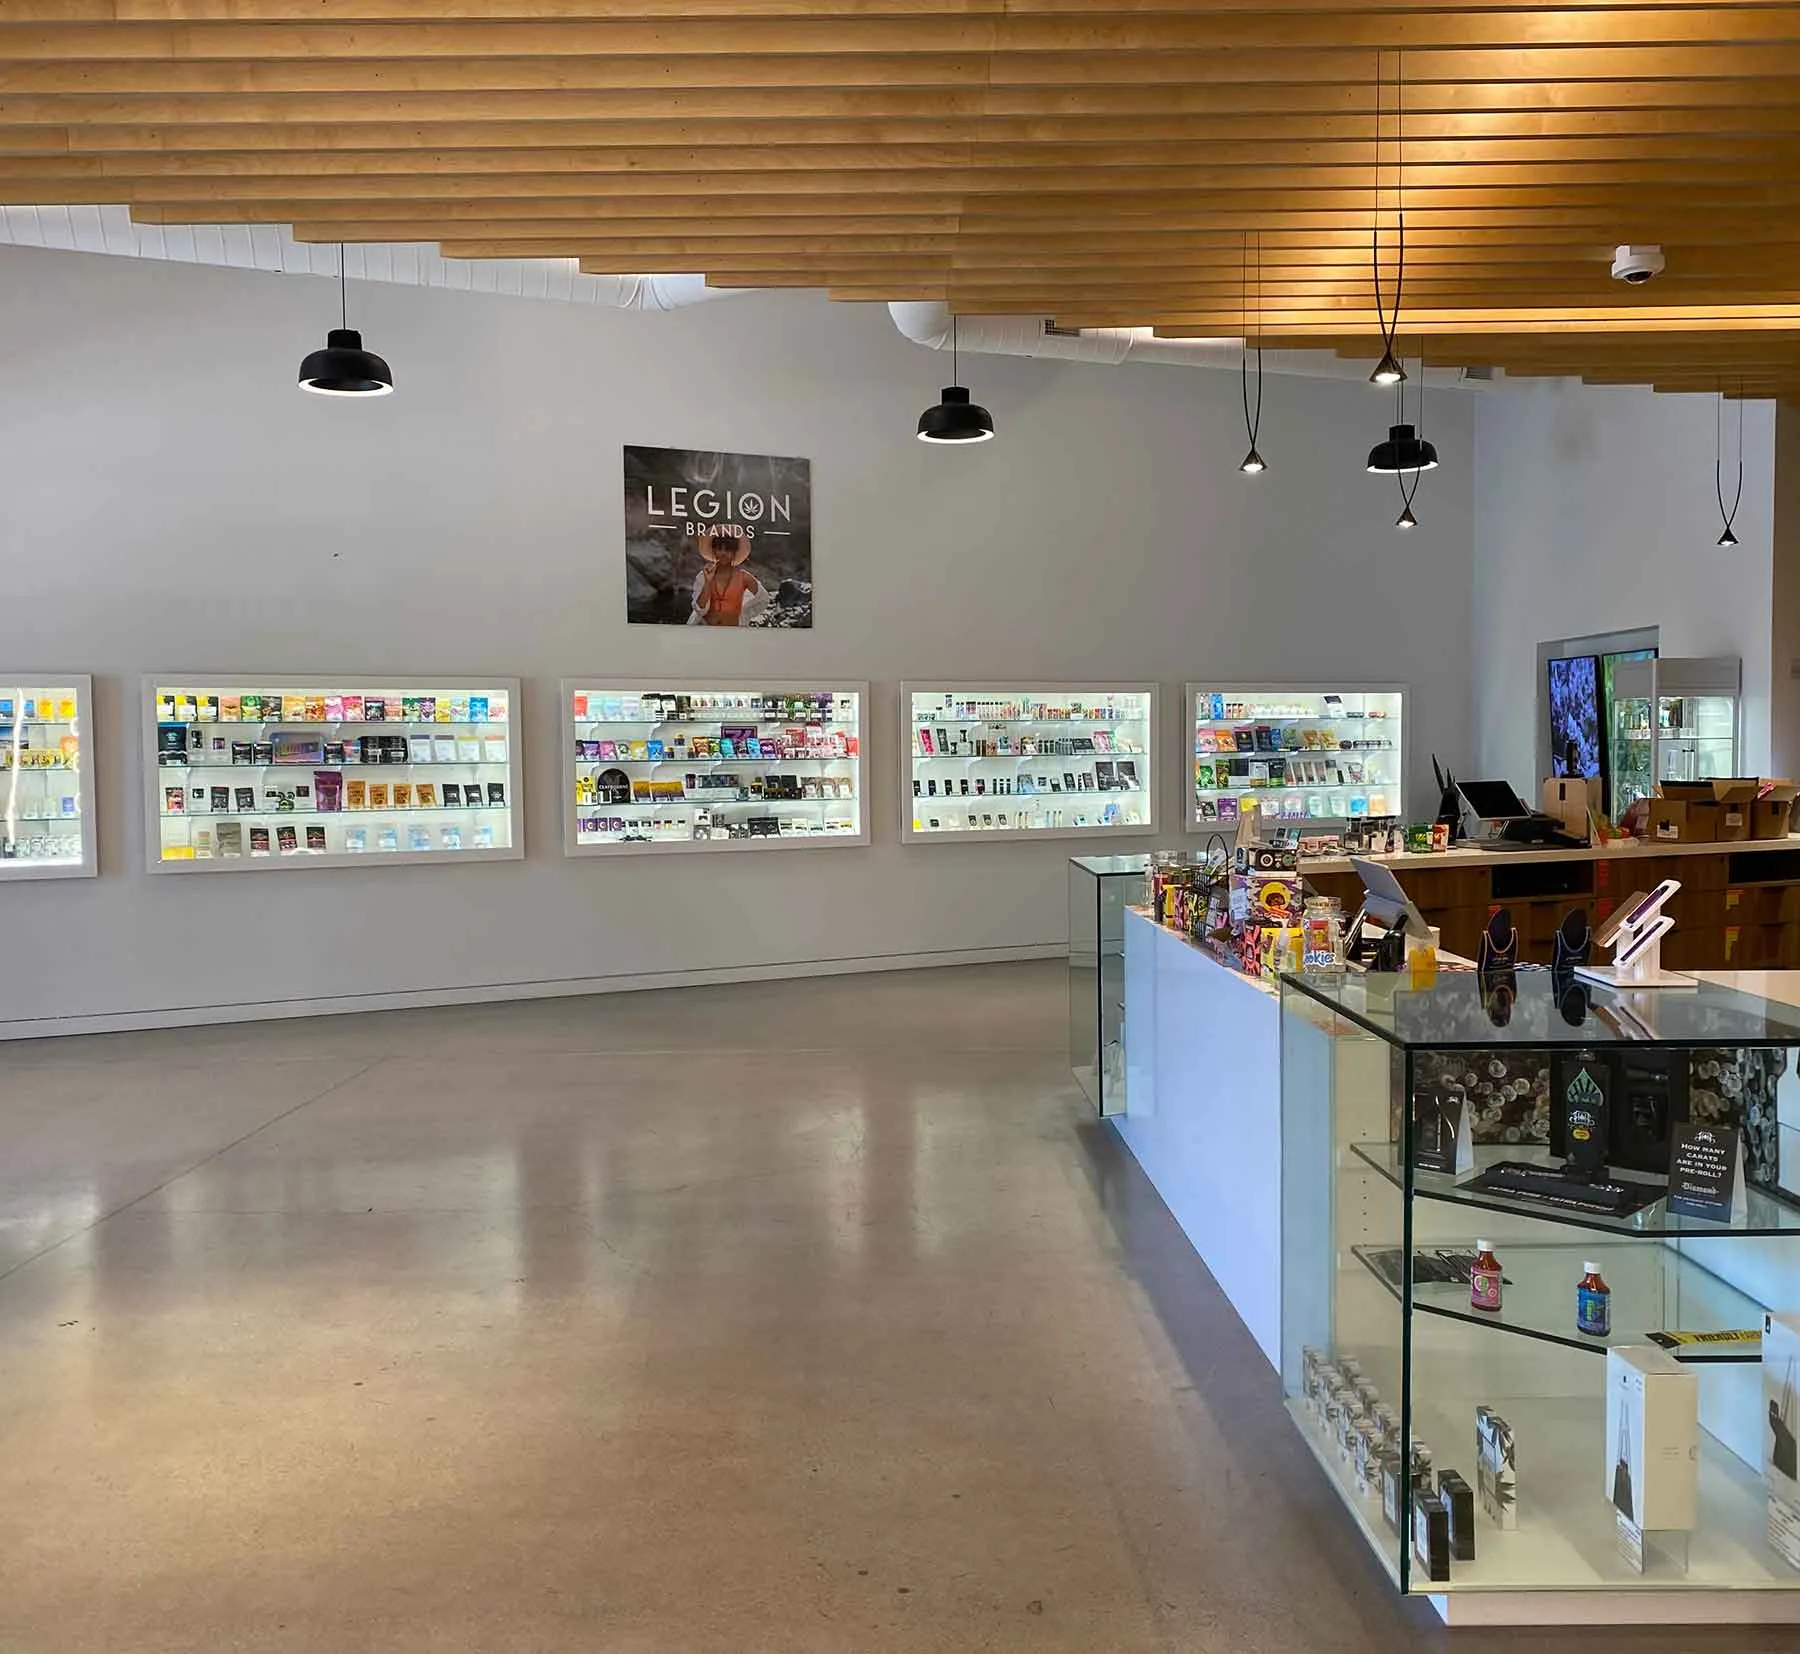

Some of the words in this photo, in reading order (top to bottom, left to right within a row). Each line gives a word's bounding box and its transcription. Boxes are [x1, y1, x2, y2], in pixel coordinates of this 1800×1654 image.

[646, 485, 792, 522] LEGION
[685, 521, 755, 539] BRANDS
[1681, 1143, 1701, 1151] HOW
[1702, 1146, 1725, 1155] MANY
[1686, 1152, 1718, 1162] CARATS
[1676, 1158, 1693, 1166] ARE
[1694, 1160, 1703, 1168] IN
[1706, 1163, 1727, 1171] YOUR
[1679, 1167, 1722, 1179] PRE-ROLL?
